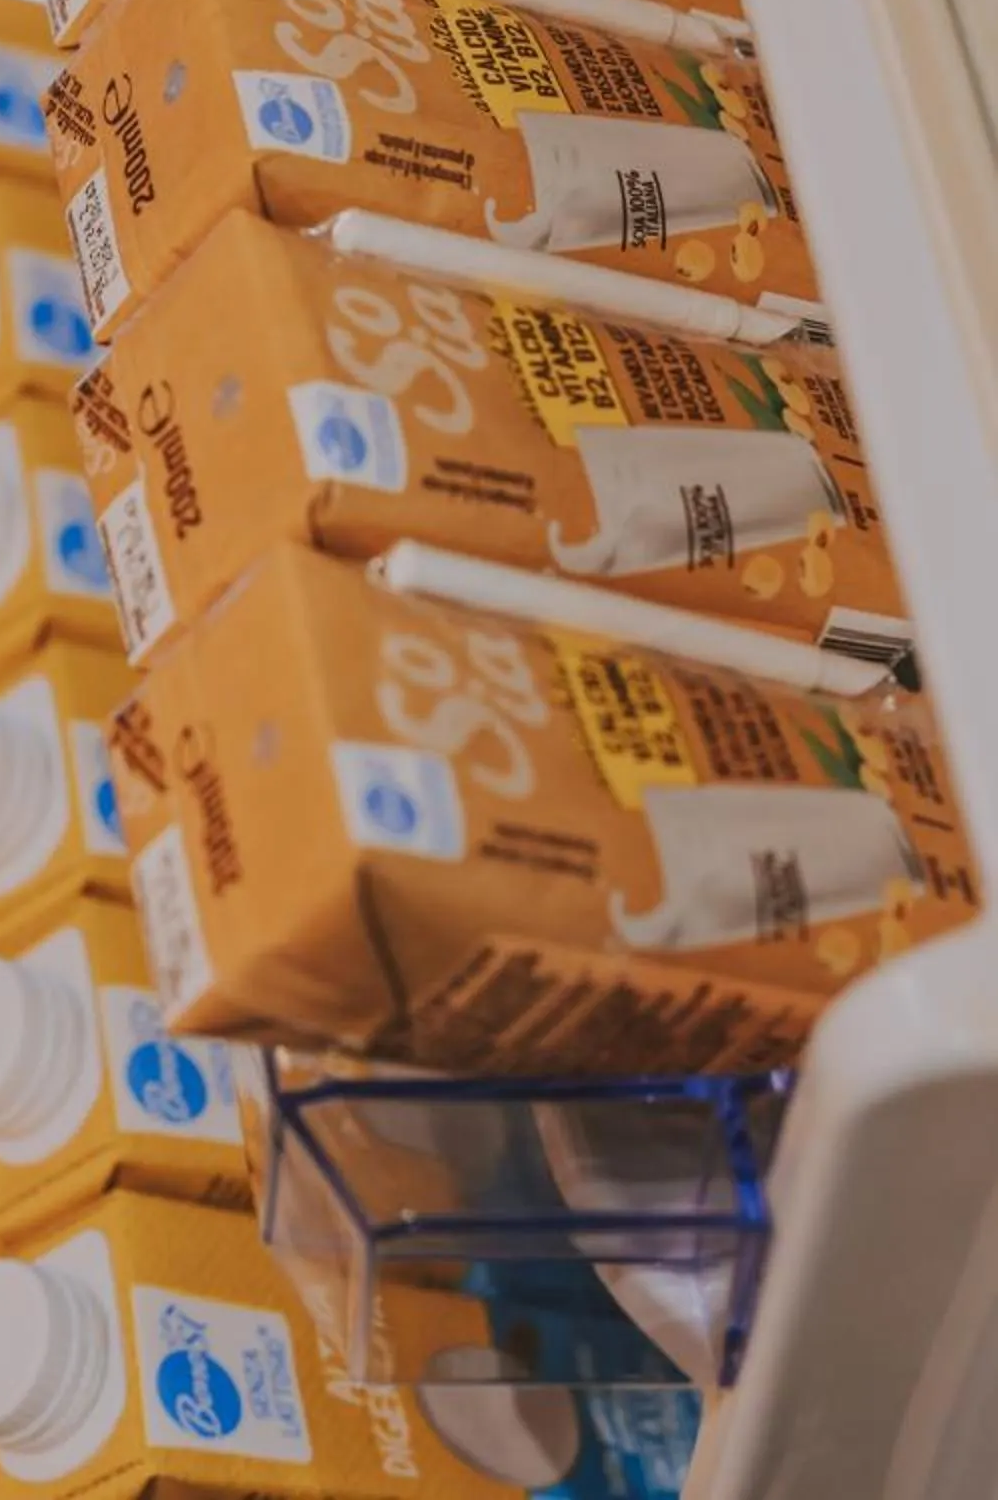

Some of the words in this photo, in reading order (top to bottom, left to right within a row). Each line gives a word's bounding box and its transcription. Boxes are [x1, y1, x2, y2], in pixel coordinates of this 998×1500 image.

[456, 17, 505, 85] CALCIO
[114, 110, 156, 217] 200ml
[624, 169, 645, 212] 100%
[631, 216, 647, 248] SOIA
[511, 319, 561, 398] CALCIO
[530, 308, 587, 406] VITAMIN
